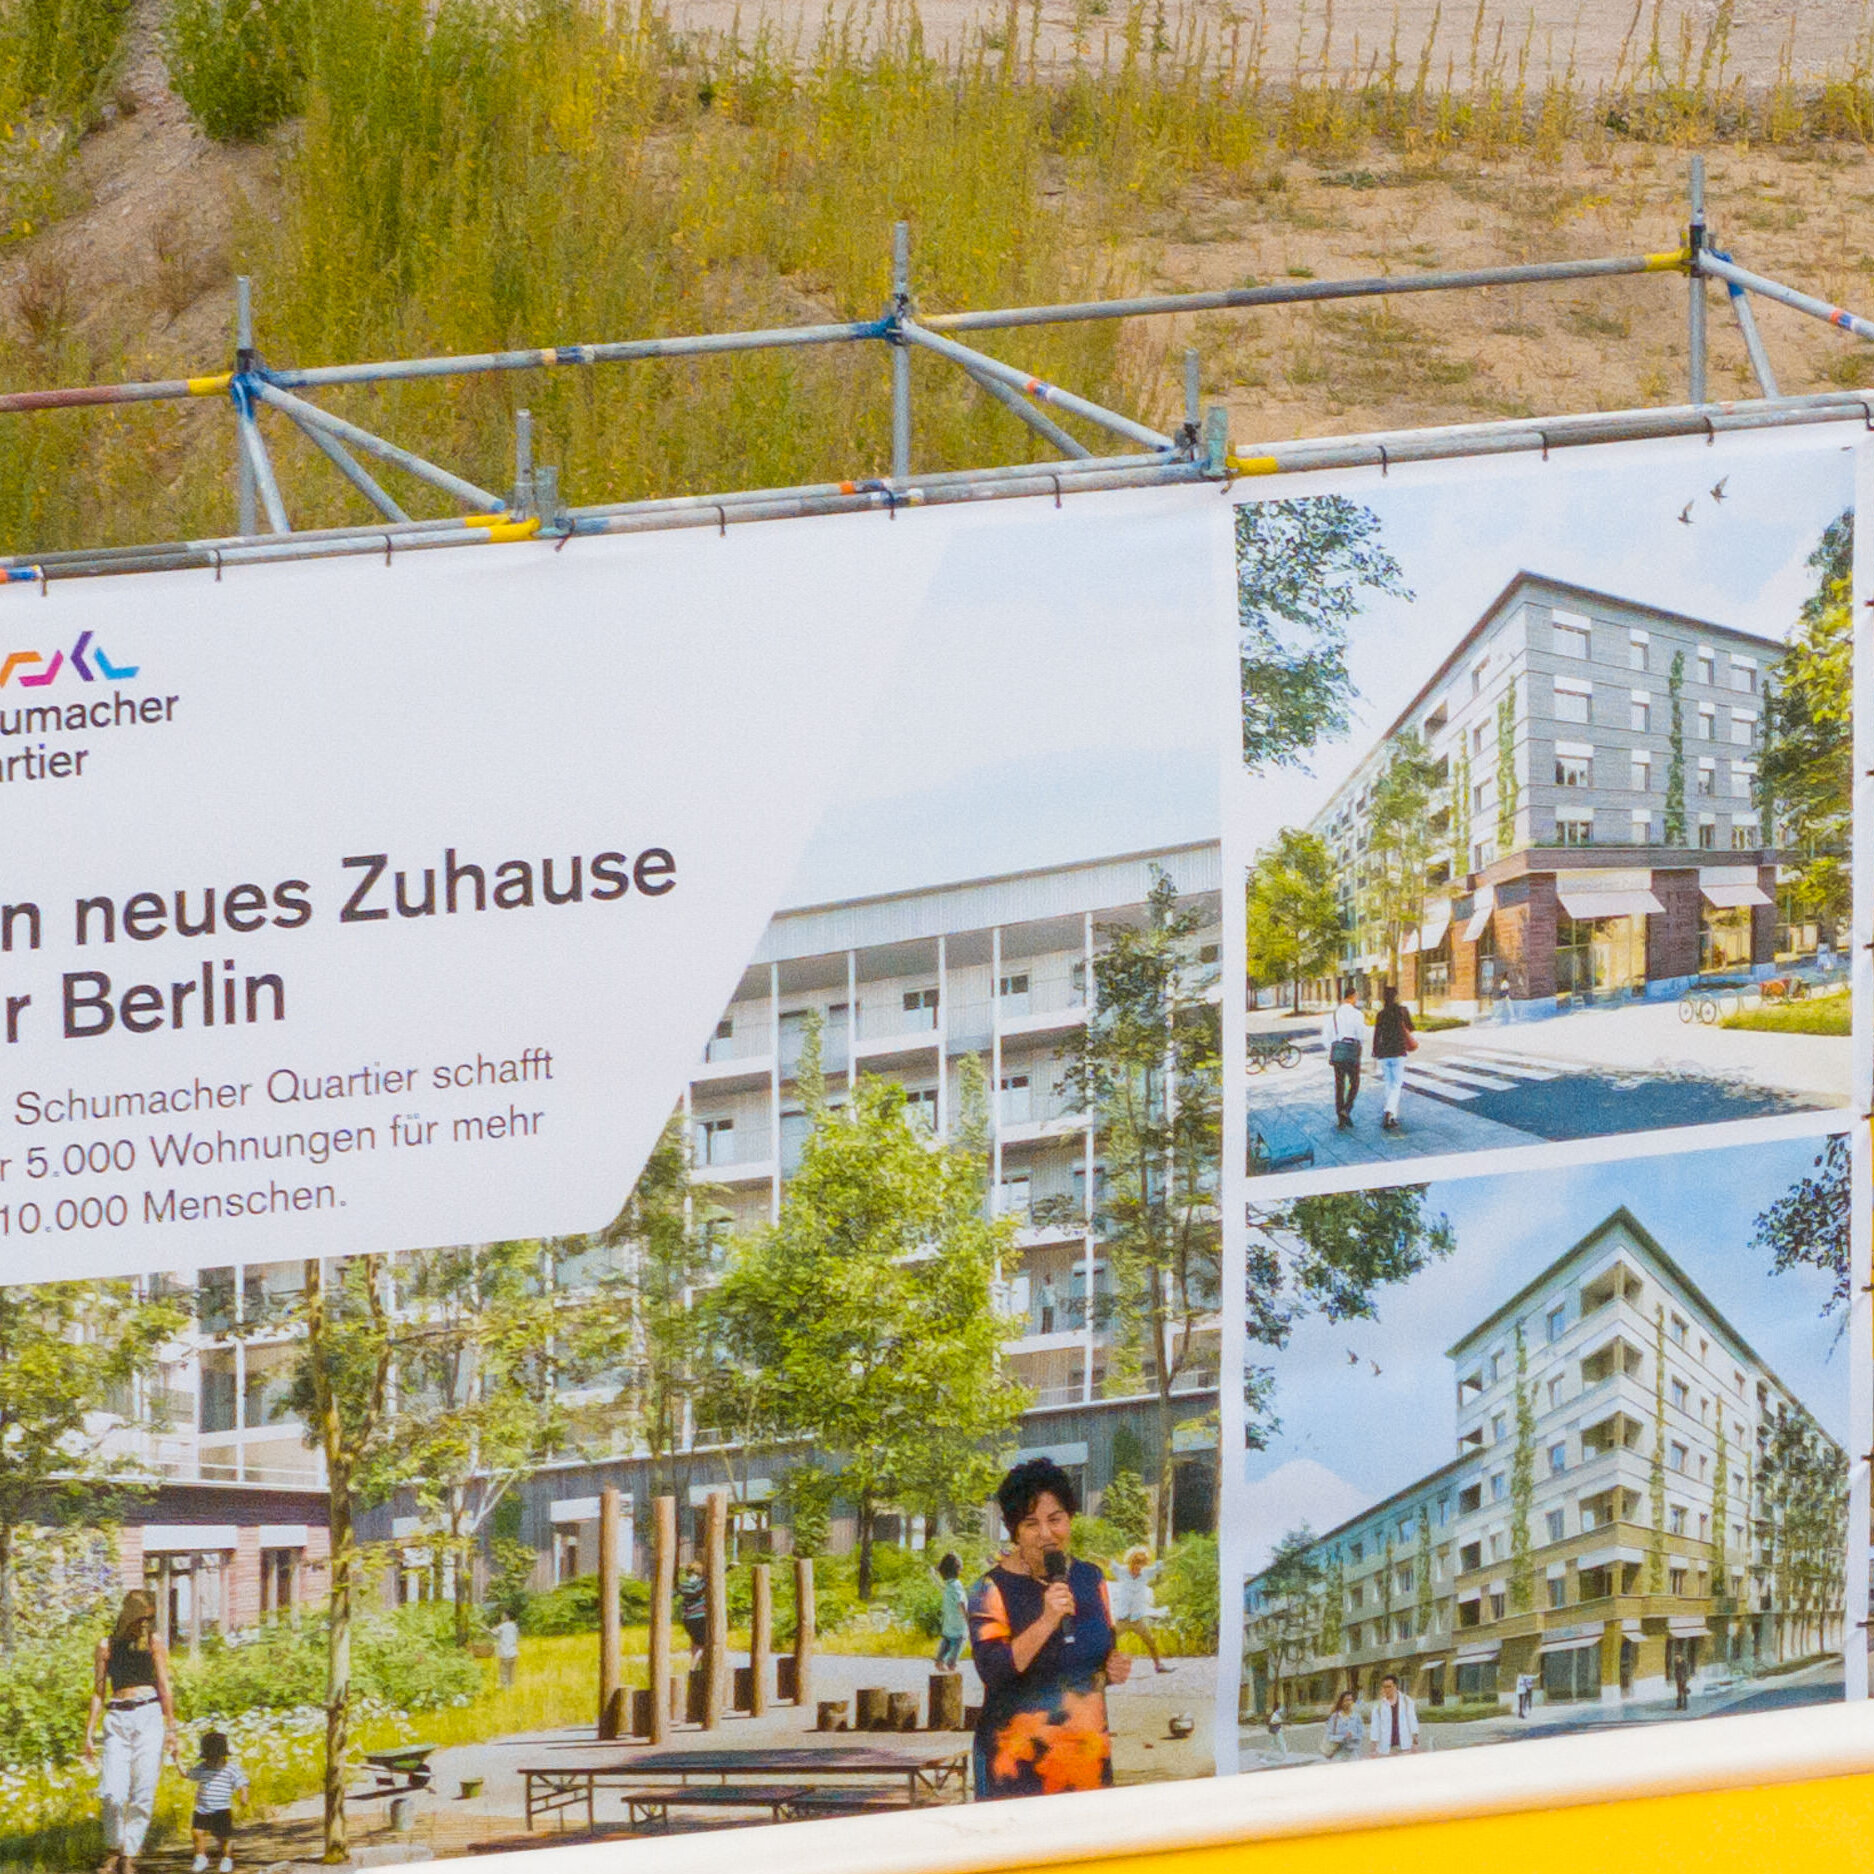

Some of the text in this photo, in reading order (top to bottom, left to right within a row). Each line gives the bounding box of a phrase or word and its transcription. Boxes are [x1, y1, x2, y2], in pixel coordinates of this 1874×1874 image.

[75, 879, 312, 946] neues
[340, 847, 677, 924] Zuhause
[62, 958, 286, 1040] Berlin
[15, 1047, 554, 1126] Schumacher Quartier schafft
[27, 1139, 136, 1179] 5.000
[148, 1126, 376, 1170] Wohnungen
[390, 1112, 438, 1147] für
[452, 1105, 545, 1142] mehr
[0, 1180, 347, 1236] 10.000 Menschen.
